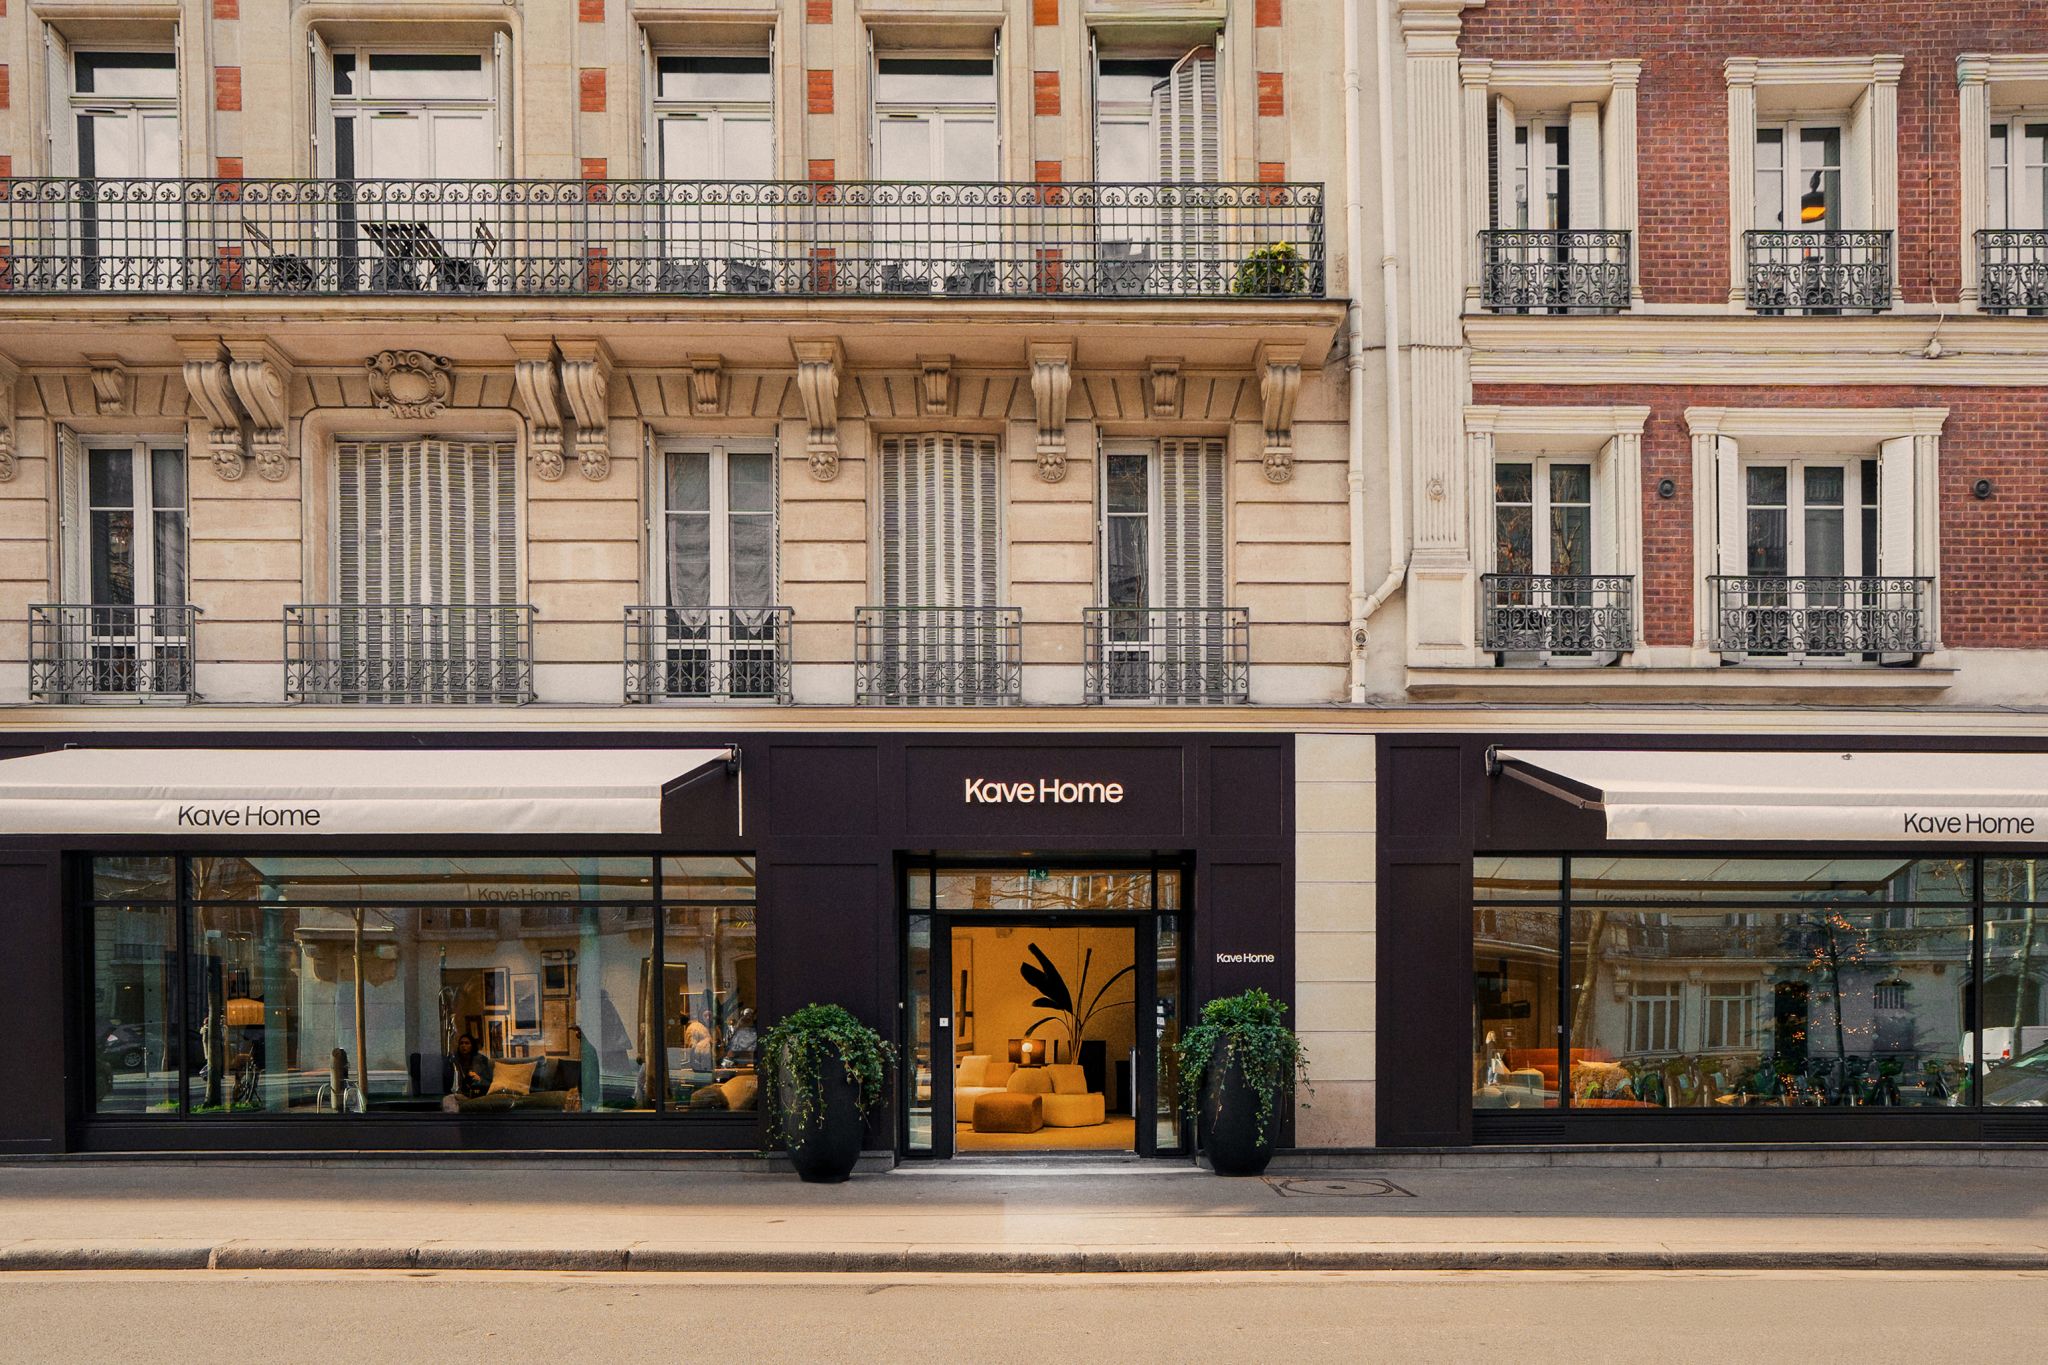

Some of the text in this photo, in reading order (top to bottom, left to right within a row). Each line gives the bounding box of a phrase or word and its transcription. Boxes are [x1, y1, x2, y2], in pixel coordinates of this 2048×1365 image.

[965, 778, 1124, 803] Kave Home
[178, 805, 321, 826] Kave Home
[1904, 812, 2035, 834] Kave Home
[1216, 953, 1275, 963] Kave Home
